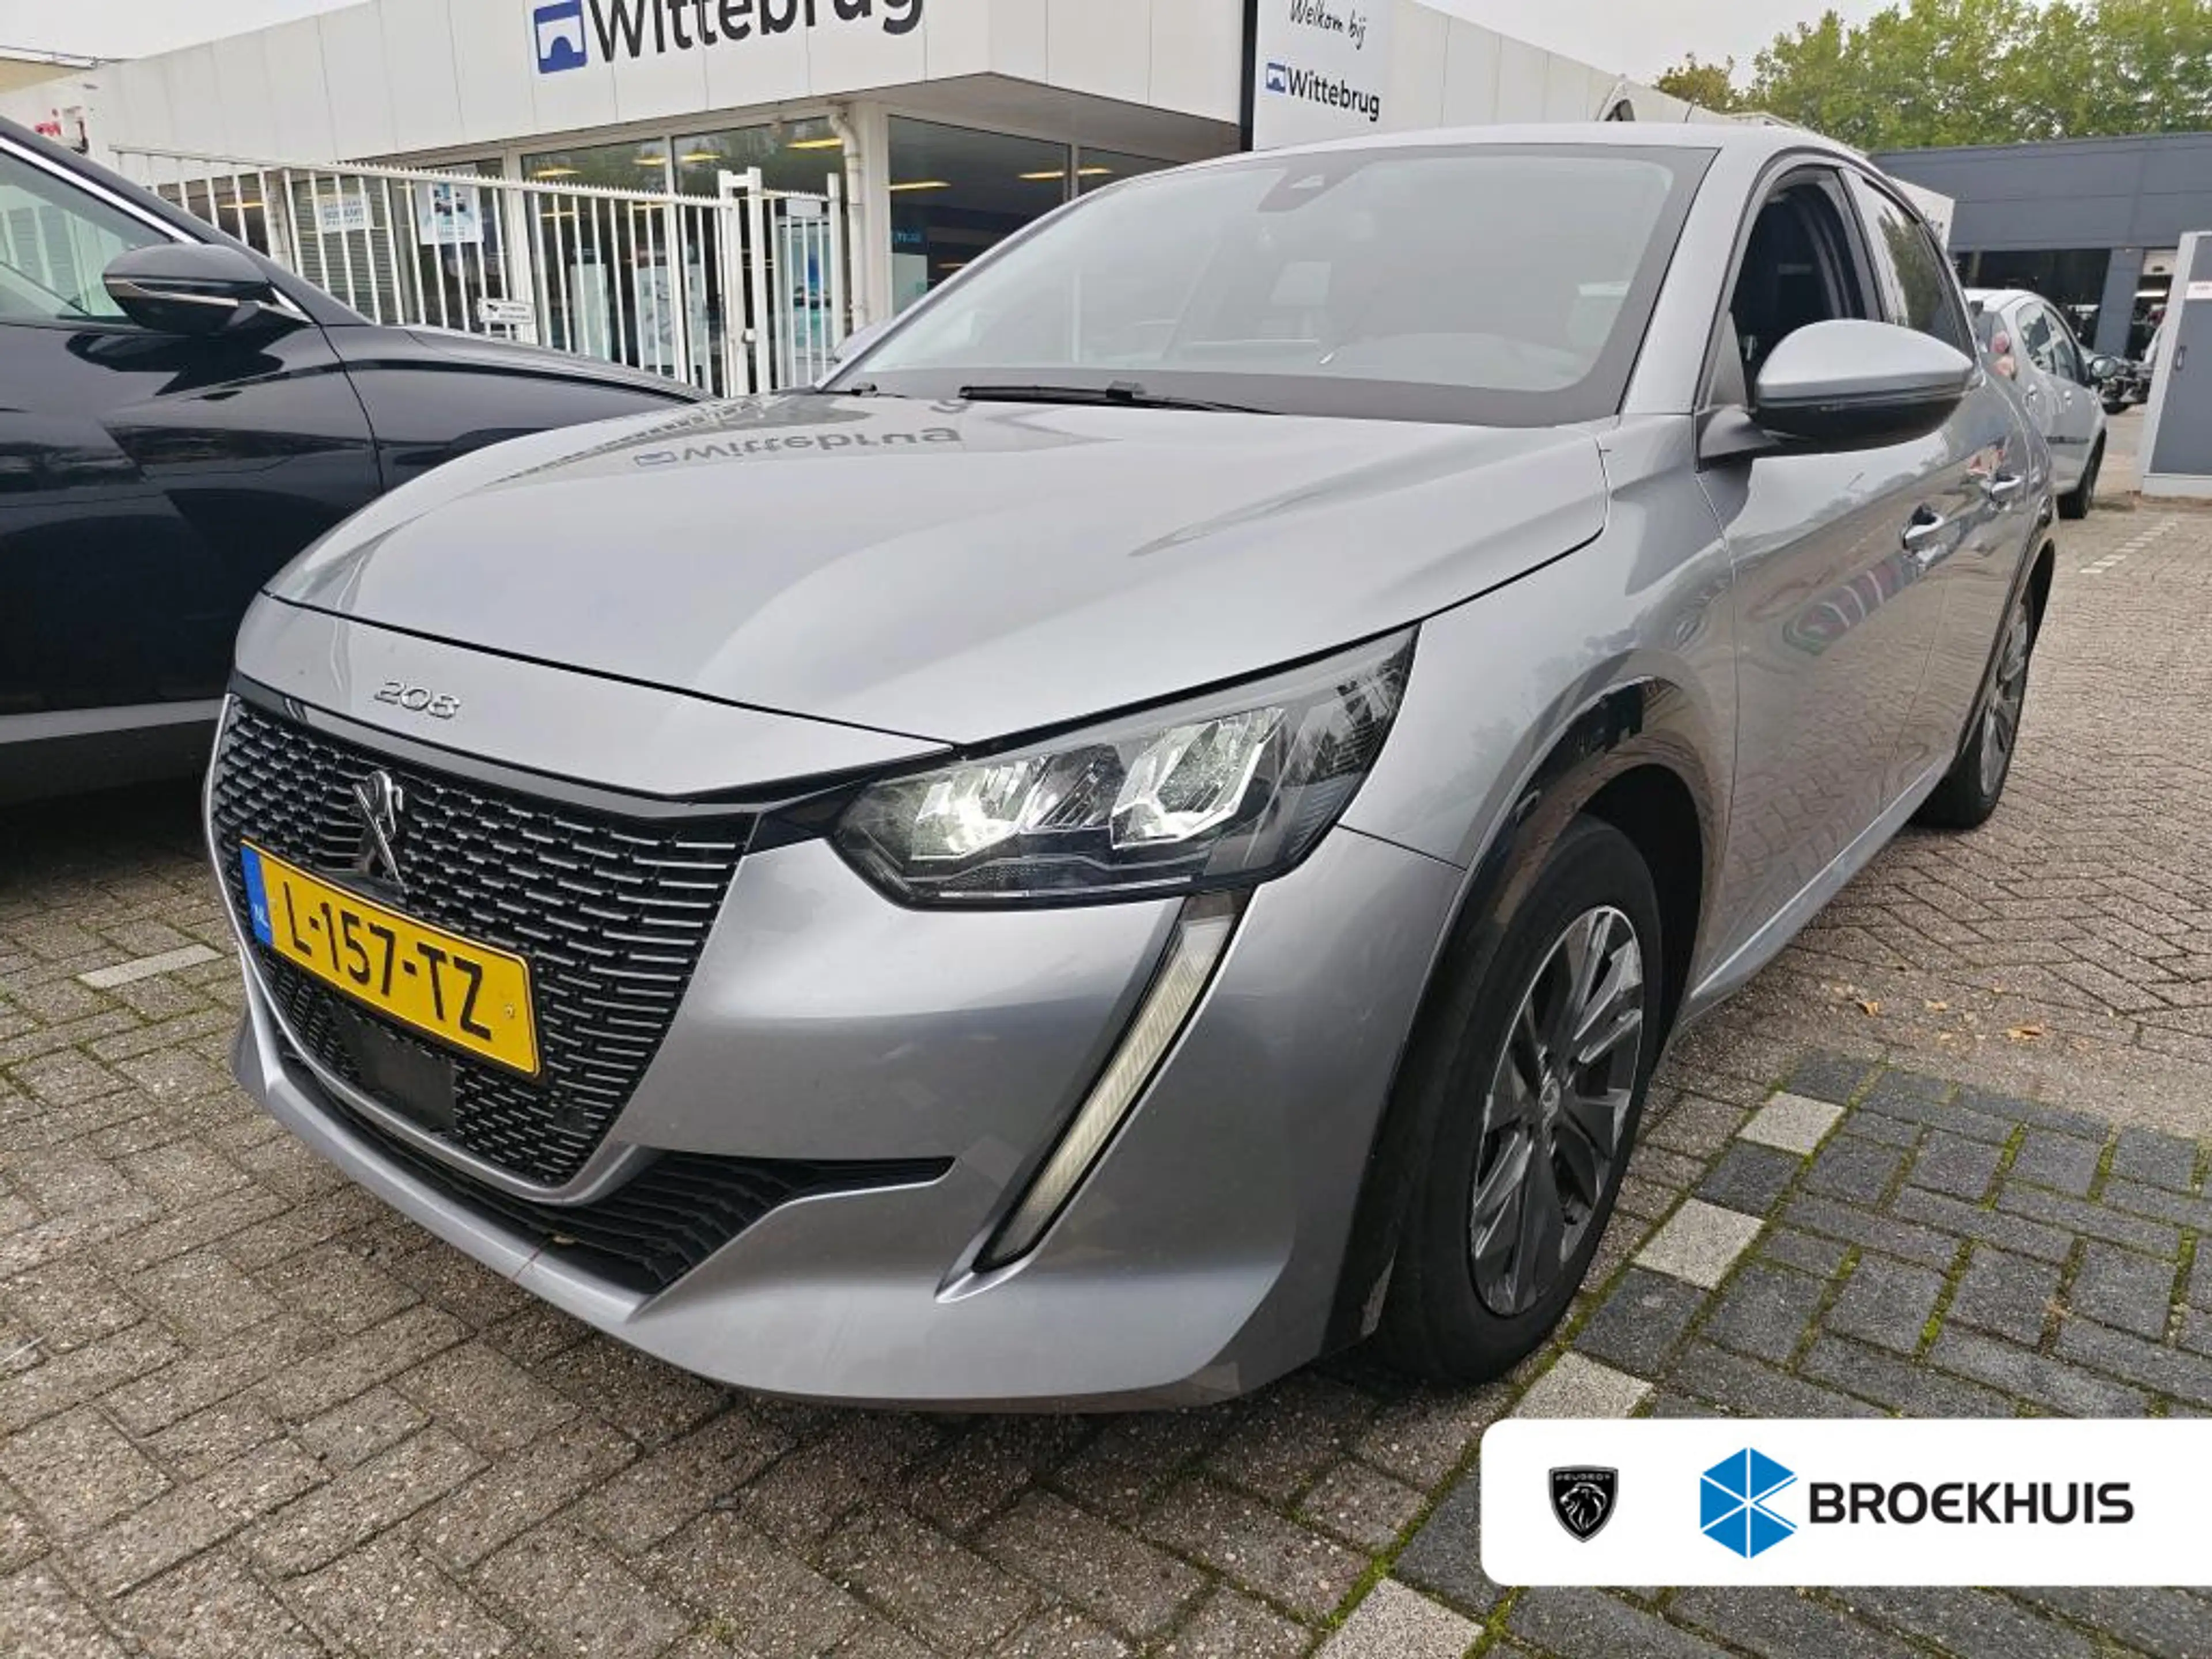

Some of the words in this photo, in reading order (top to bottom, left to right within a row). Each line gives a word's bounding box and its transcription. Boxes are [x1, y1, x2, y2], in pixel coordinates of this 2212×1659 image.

[1290, 0, 1343, 33] Welkom
[1349, 9, 1366, 50] bij
[1287, 67, 1380, 122] Wittebrug
[283, 881, 492, 1041] L-157-TZ
